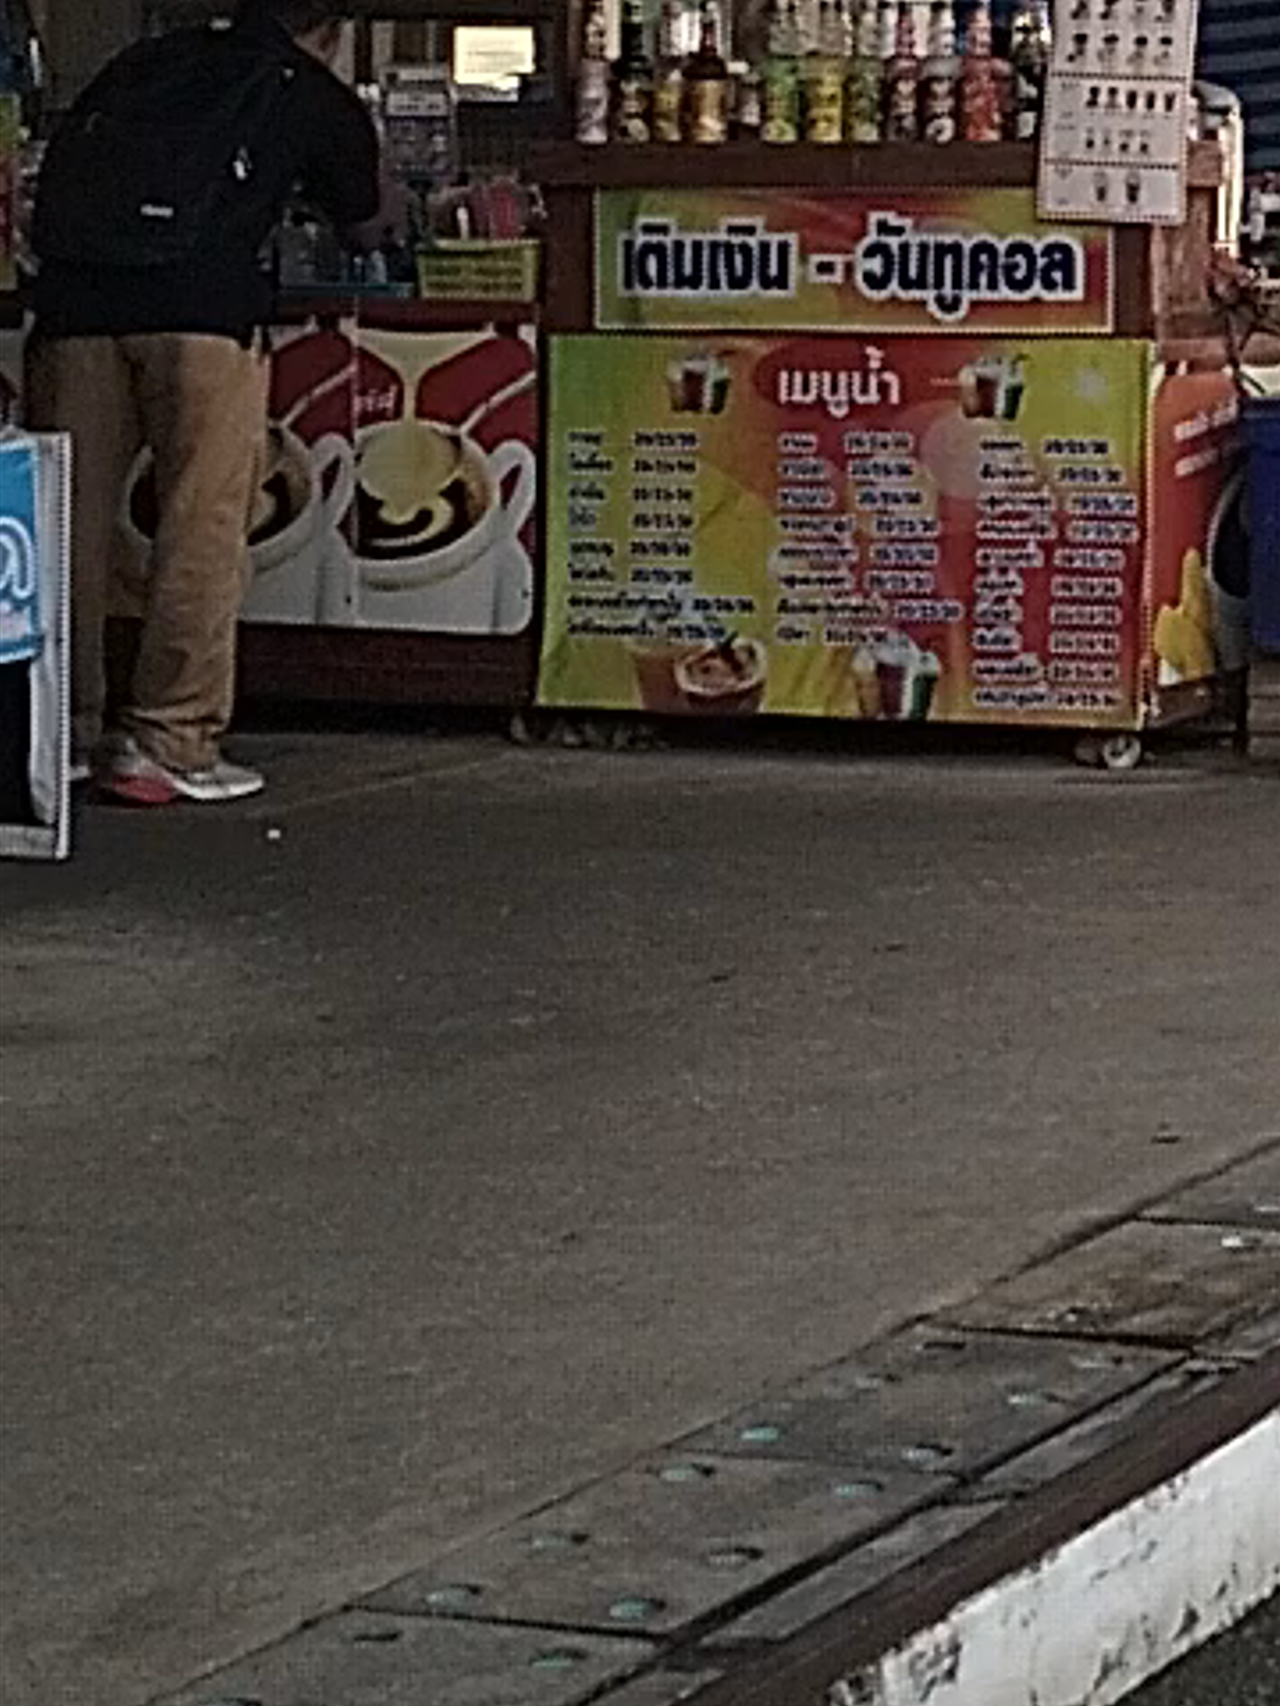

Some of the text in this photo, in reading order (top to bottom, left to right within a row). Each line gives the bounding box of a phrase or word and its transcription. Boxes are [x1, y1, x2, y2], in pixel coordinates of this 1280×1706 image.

[623, 223, 791, 289] เติมเงิน
[863, 215, 1077, 314] วันทูคอล
[779, 346, 900, 416] เมนูน้ำ
